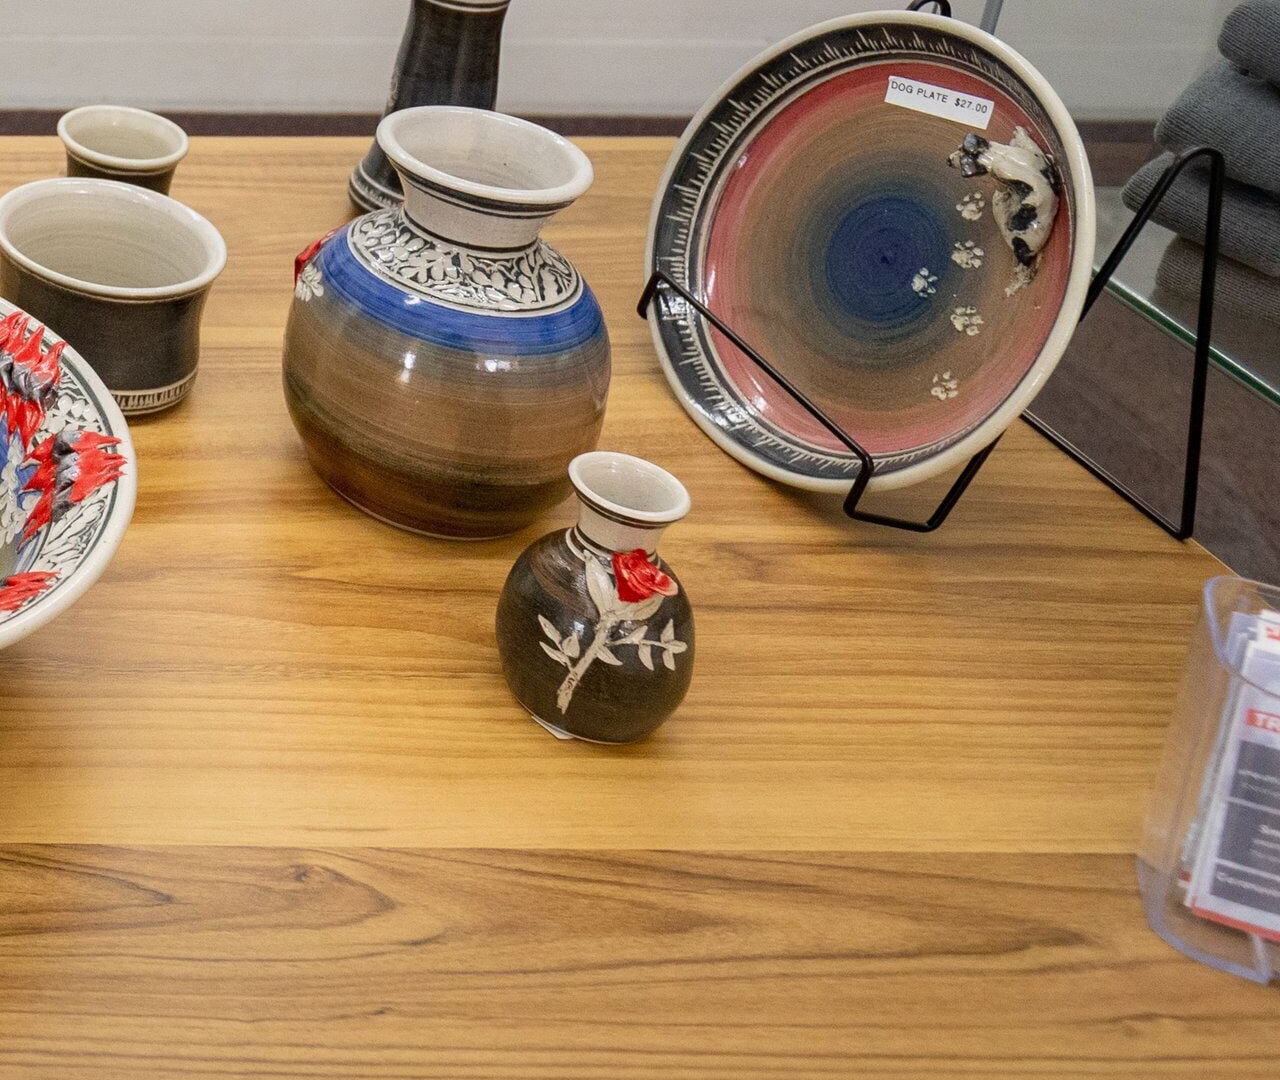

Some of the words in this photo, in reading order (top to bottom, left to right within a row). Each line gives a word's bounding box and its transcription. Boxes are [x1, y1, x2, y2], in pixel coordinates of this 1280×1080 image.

[891, 80, 914, 94] DOG
[916, 87, 949, 104] PLATE
[954, 97, 989, 114] $27.00
